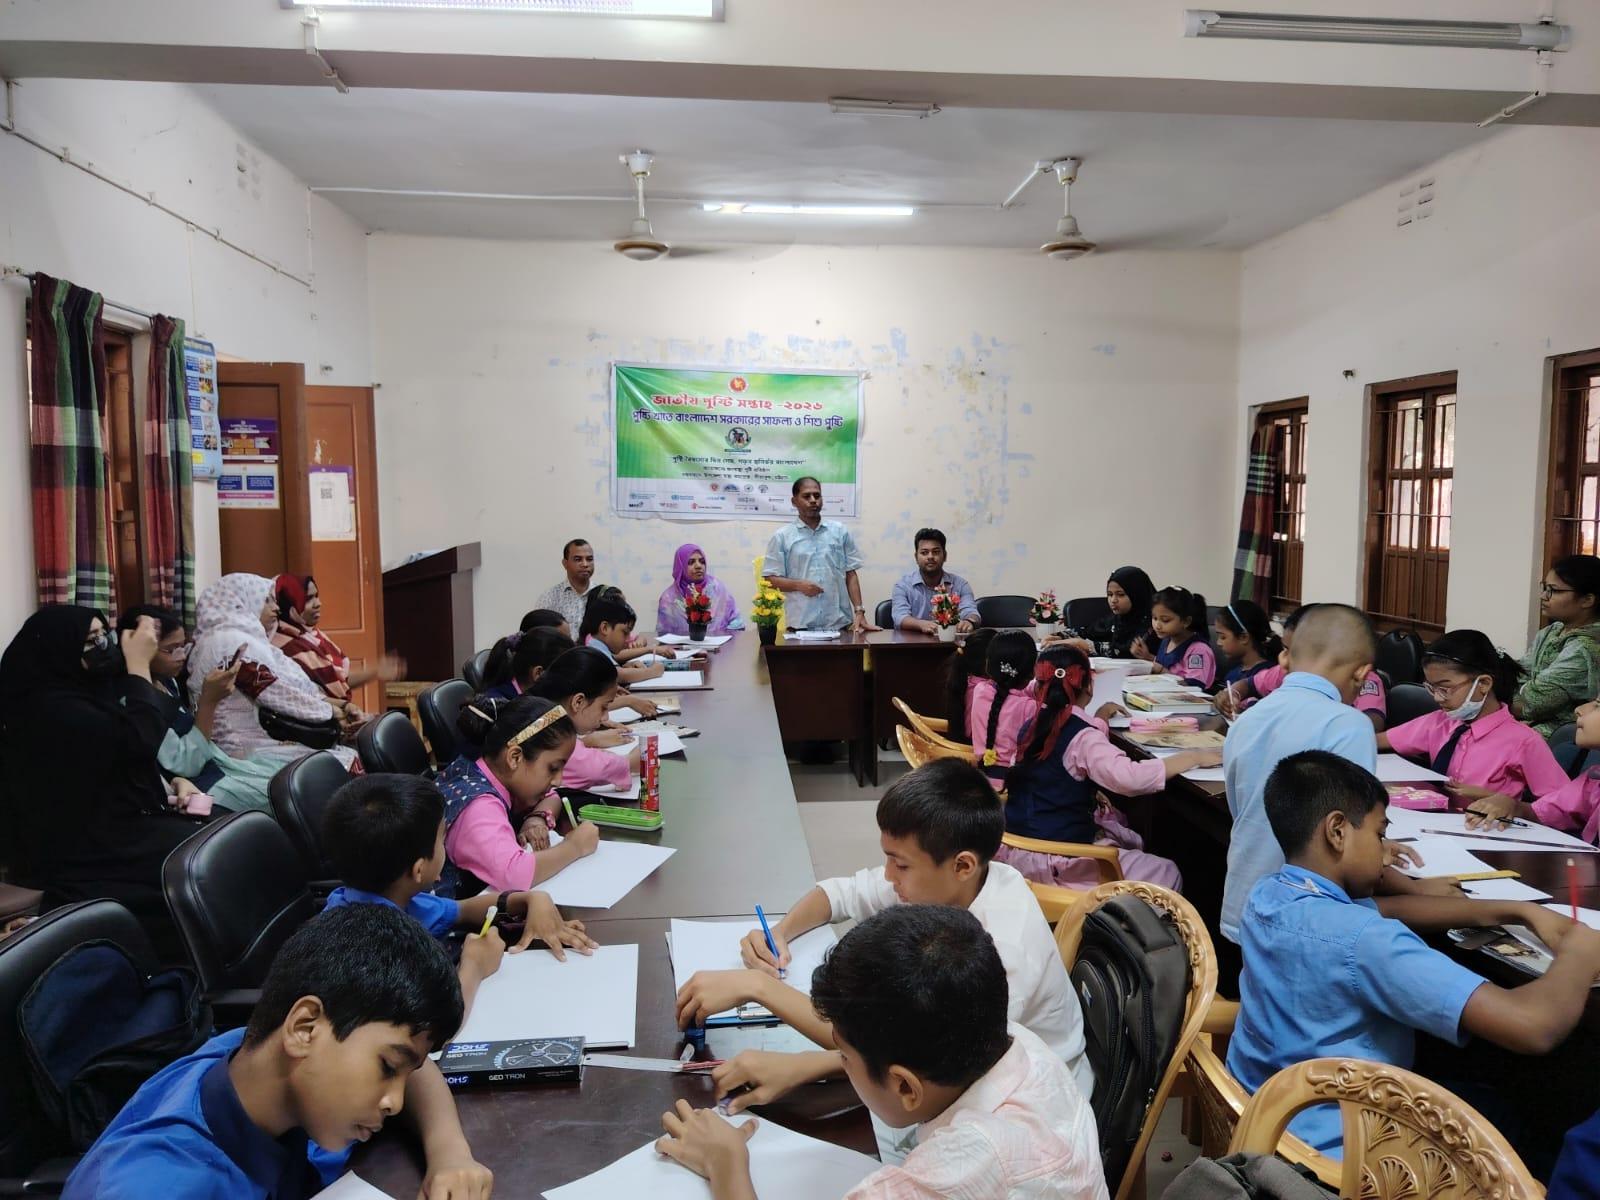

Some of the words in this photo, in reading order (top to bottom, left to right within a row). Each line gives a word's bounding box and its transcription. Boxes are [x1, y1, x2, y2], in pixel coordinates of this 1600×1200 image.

[704, 395, 733, 409] পুষ্টি
[737, 398, 773, 409] সপ্তাহ
[633, 408, 651, 423] পুষ্টি
[675, 413, 718, 423] বাংলাদেশ
[720, 414, 761, 426] সরকারের
[762, 416, 793, 427] সাফল্য
[795, 418, 802, 426] ও
[804, 415, 823, 427] শিশু
[825, 416, 844, 431] পুষ্টি
